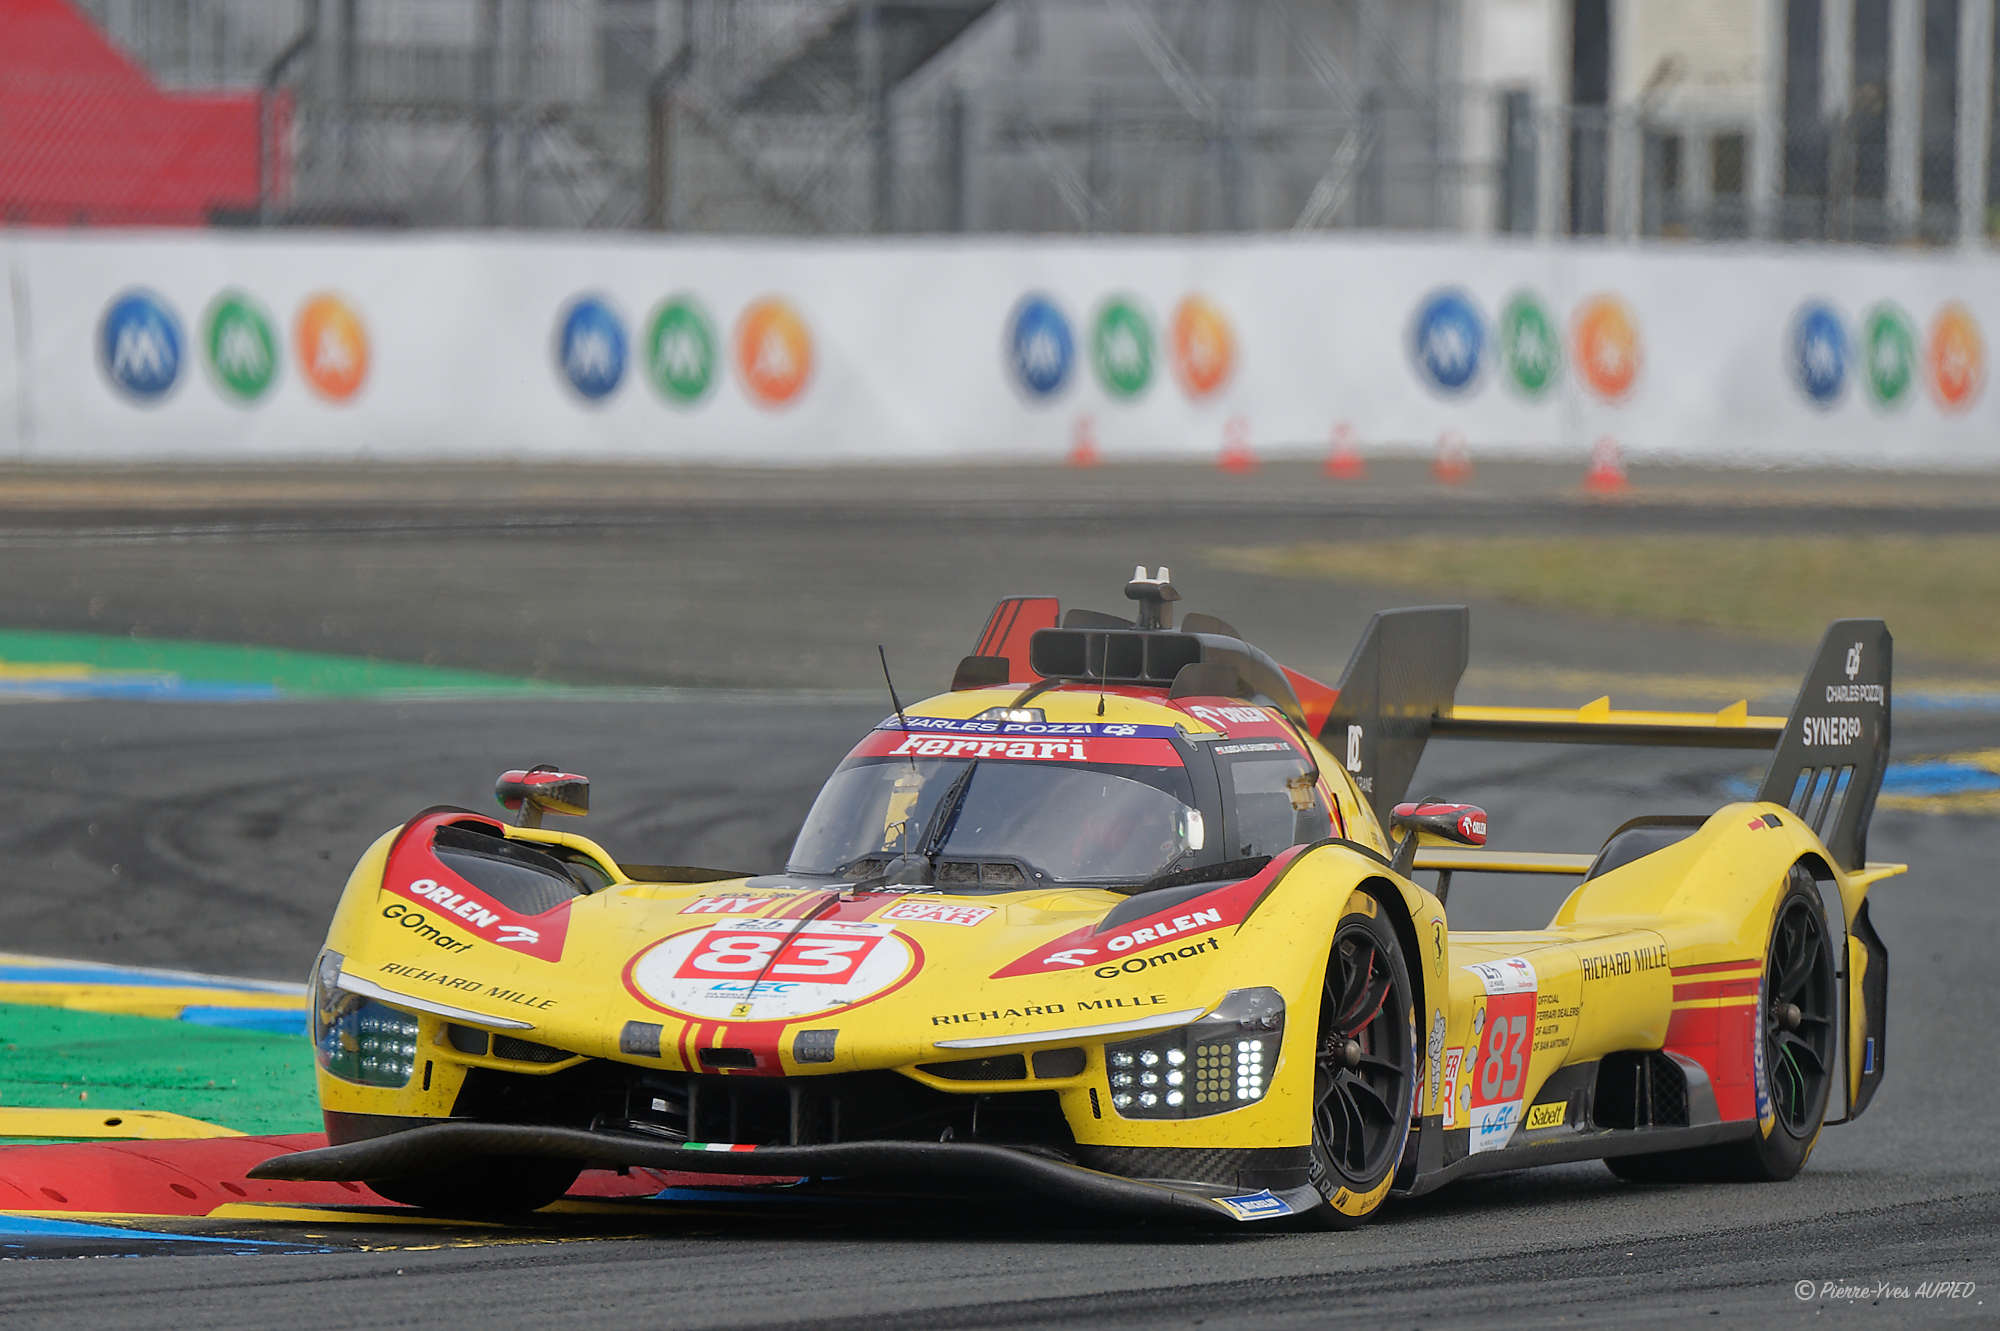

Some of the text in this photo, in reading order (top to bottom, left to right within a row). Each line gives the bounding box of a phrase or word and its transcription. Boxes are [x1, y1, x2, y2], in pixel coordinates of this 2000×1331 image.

[886, 716, 1000, 733] CHARLES
[1003, 720, 1091, 734] POZZI
[888, 734, 1087, 760] Ferrari
[409, 879, 500, 928] ORLEN
[891, 910, 977, 924] CAR
[382, 904, 473, 955] GOmart
[1107, 908, 1222, 951] ORLEN
[693, 936, 868, 977] 83
[1094, 937, 1220, 979] GOmart
[1582, 944, 1667, 980] RICHARD MILLE
[379, 962, 559, 1011] RICHARD MILLE
[932, 994, 1169, 1026] RICHARD MILLE
[1481, 1015, 1527, 1101] 83
[1531, 1106, 1562, 1126] Sabelt
